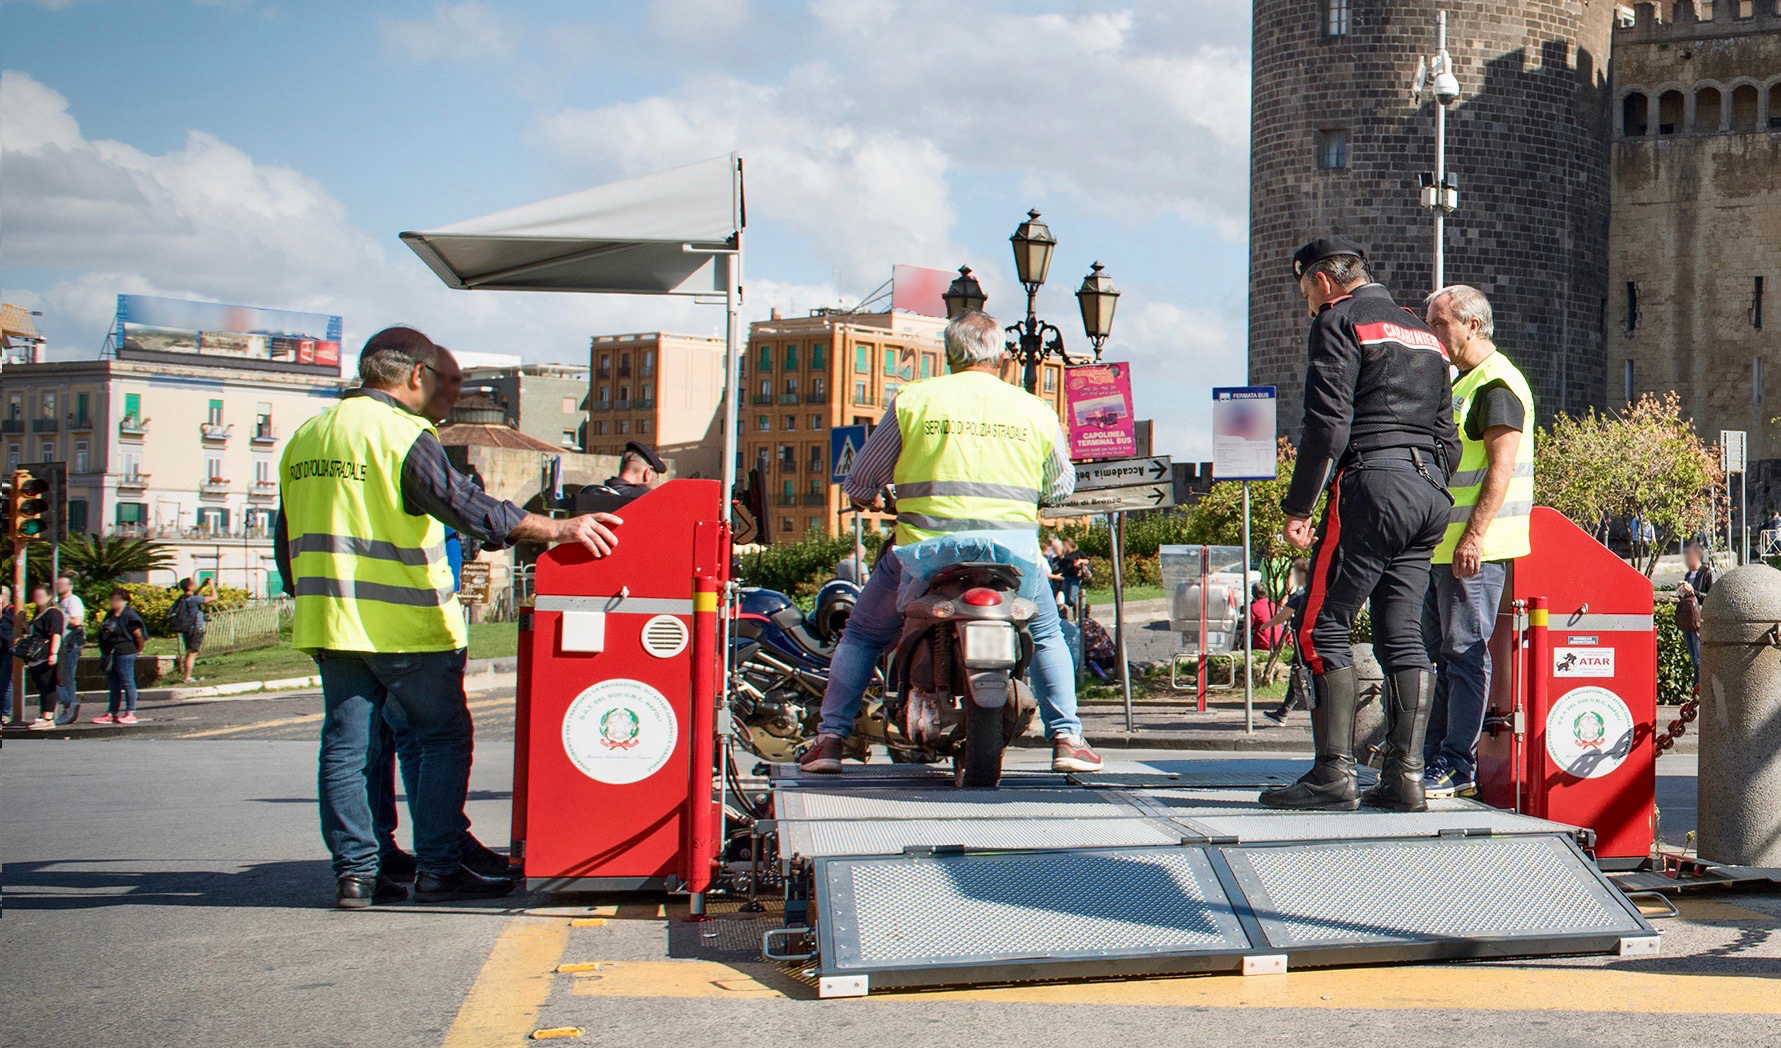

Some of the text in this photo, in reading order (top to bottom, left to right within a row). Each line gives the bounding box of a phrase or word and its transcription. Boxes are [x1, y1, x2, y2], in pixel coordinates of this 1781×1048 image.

[925, 420, 1027, 442] SERVIZIO DI POLIZIA STRADALE
[1082, 430, 1125, 440] CAPOLINEA
[1077, 436, 1132, 446] TERMINAL BUS
[330, 460, 367, 482] STRADALE
[1076, 466, 1144, 482] Accademia bel
[1050, 500, 1079, 508] Cavalli
[1091, 498, 1122, 506] Bronzo
[1580, 658, 1610, 666] ATAR
